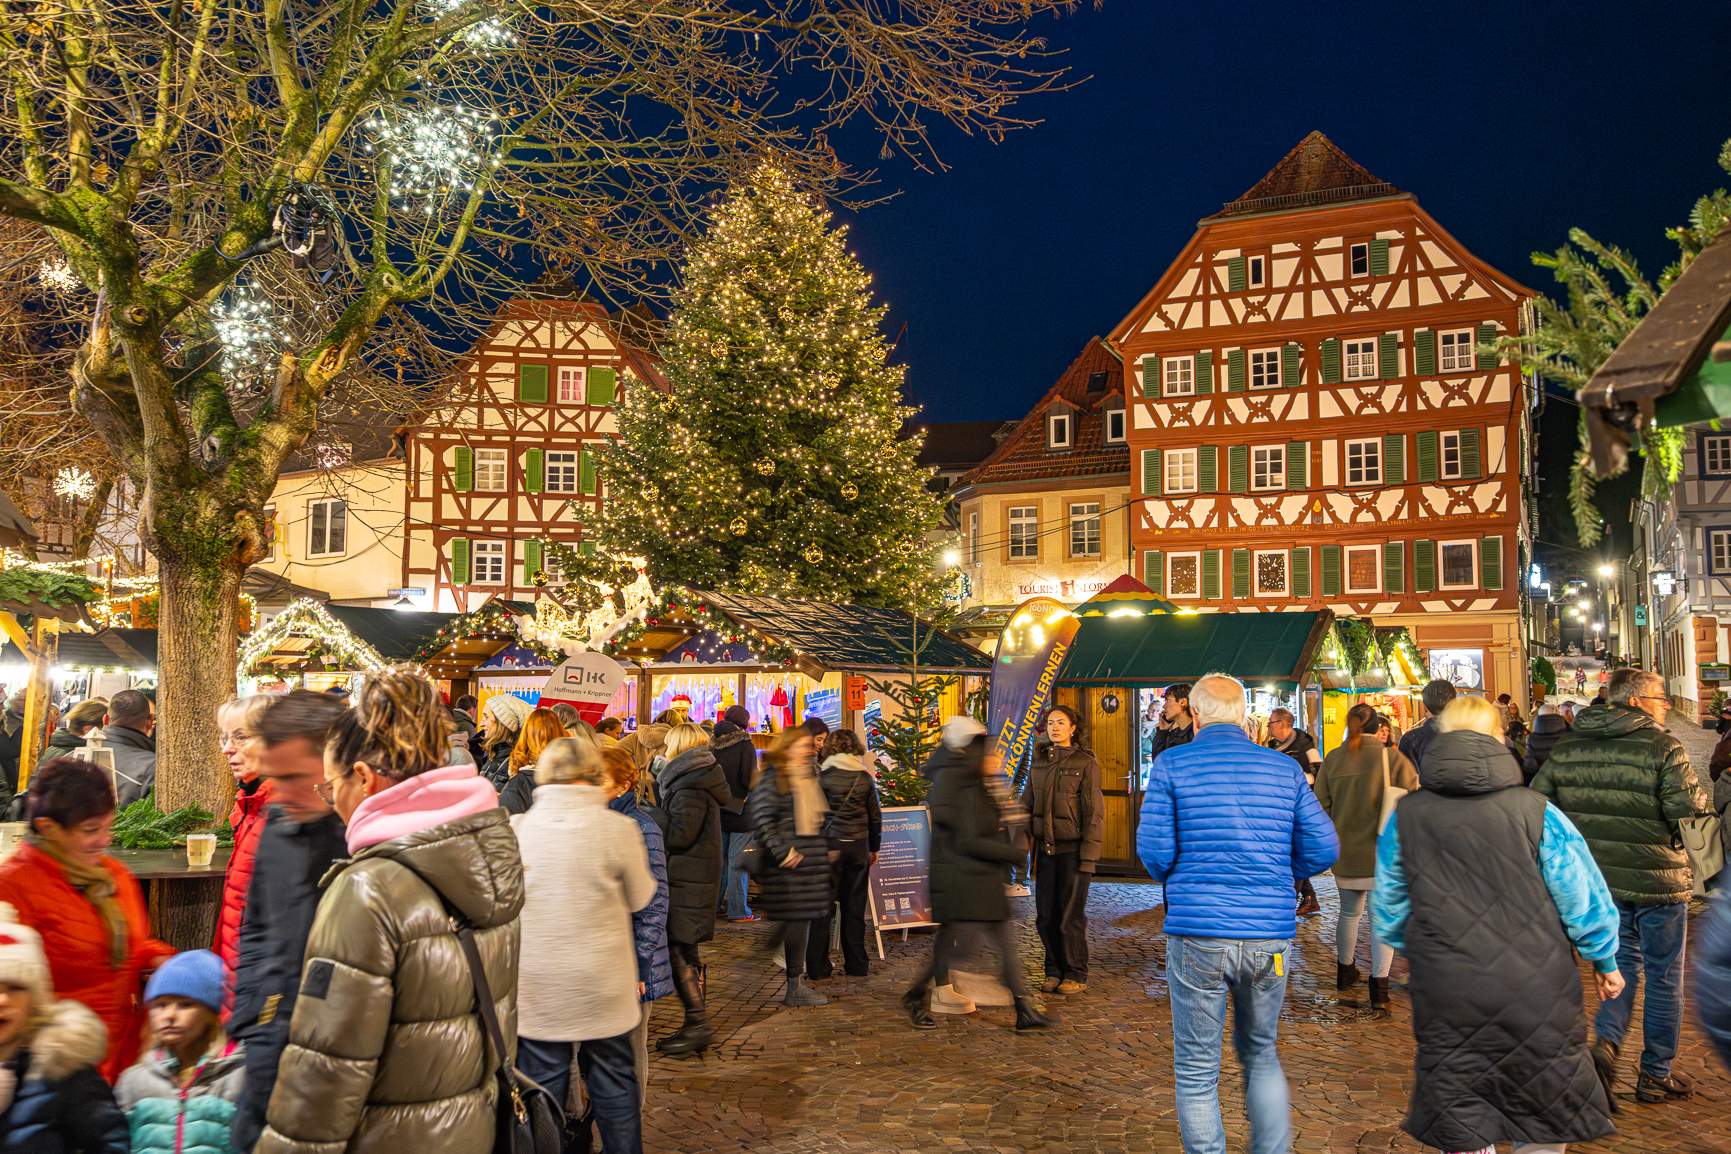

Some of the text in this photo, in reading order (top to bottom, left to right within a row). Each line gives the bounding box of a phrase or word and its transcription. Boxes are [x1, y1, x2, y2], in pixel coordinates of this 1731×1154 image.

[553, 686, 582, 695] Hoffmann
[587, 690, 612, 698] Krippner
[851, 689, 861, 700] 11
[1104, 697, 1117, 708] 14
[1004, 641, 1067, 778] #KÖNNENLERNEN
[993, 717, 1017, 769] JETZT
